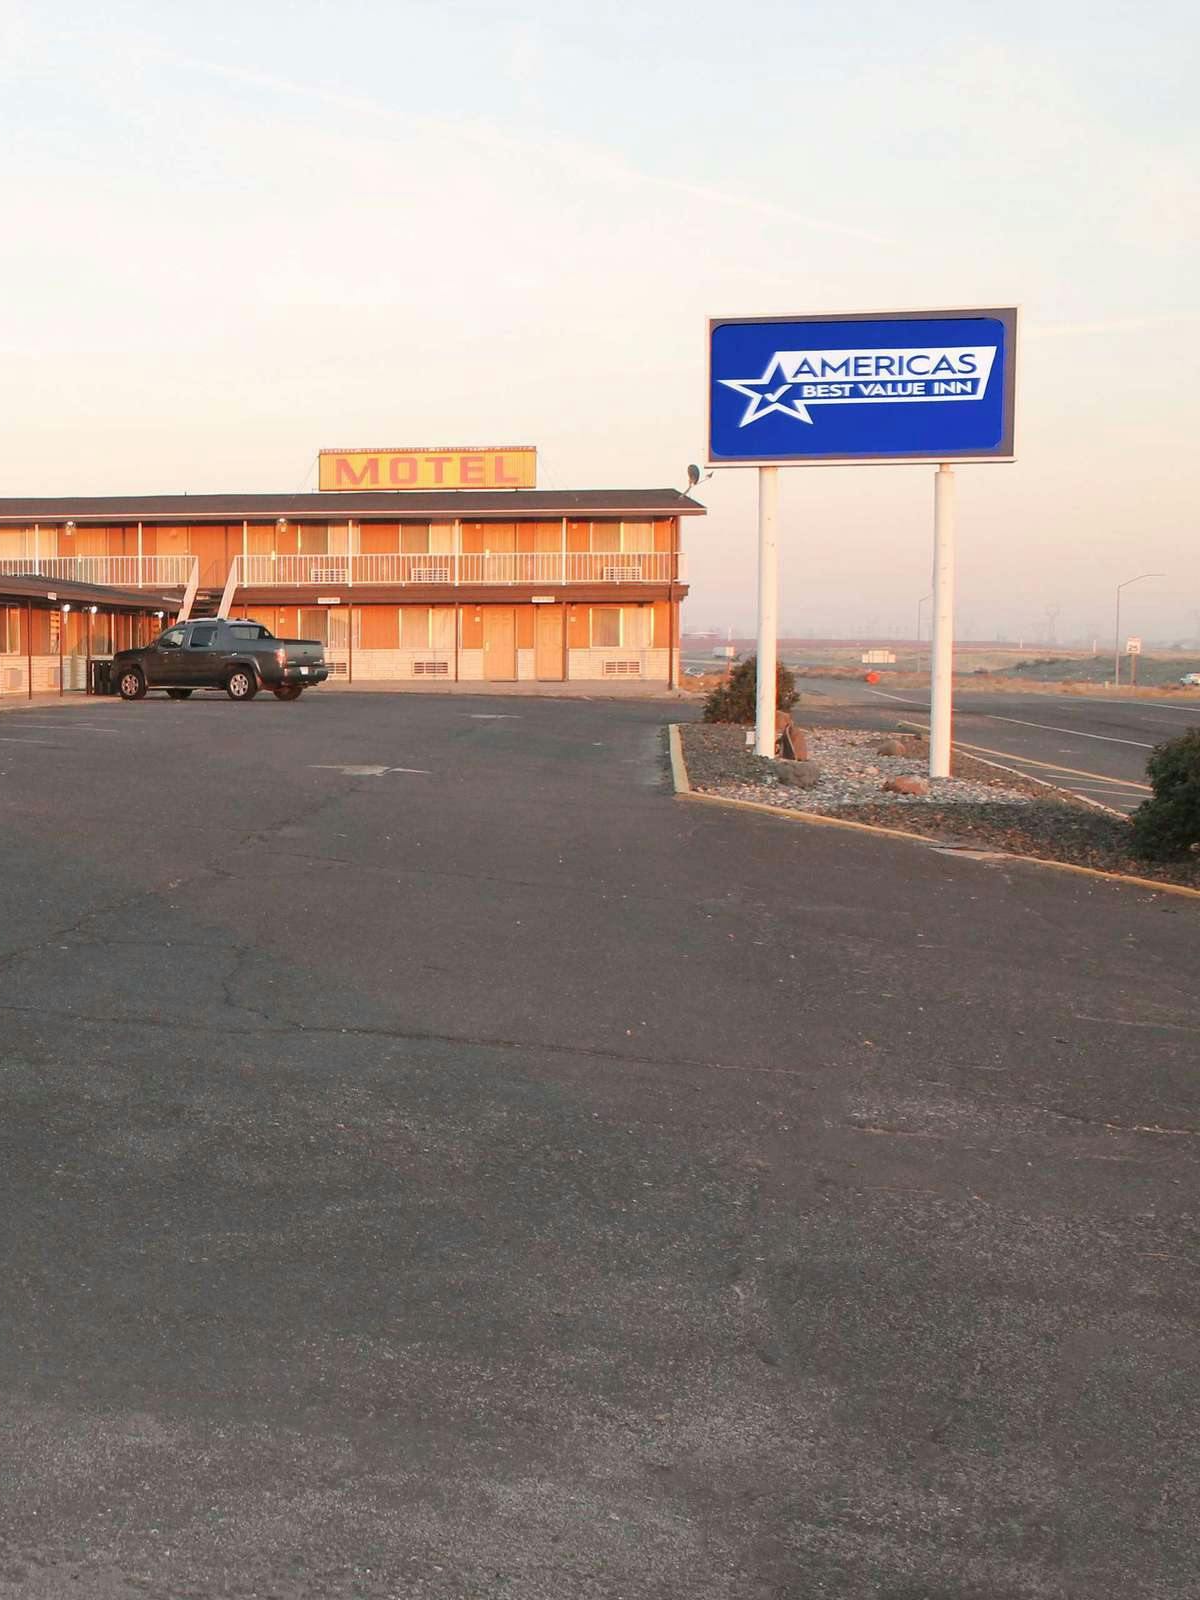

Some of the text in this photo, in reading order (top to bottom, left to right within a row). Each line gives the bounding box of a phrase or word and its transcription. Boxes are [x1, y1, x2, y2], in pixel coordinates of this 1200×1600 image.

[793, 354, 977, 377] AMERICAS
[802, 380, 972, 398] BEST VALUE INN
[336, 456, 520, 485] MOTEL
